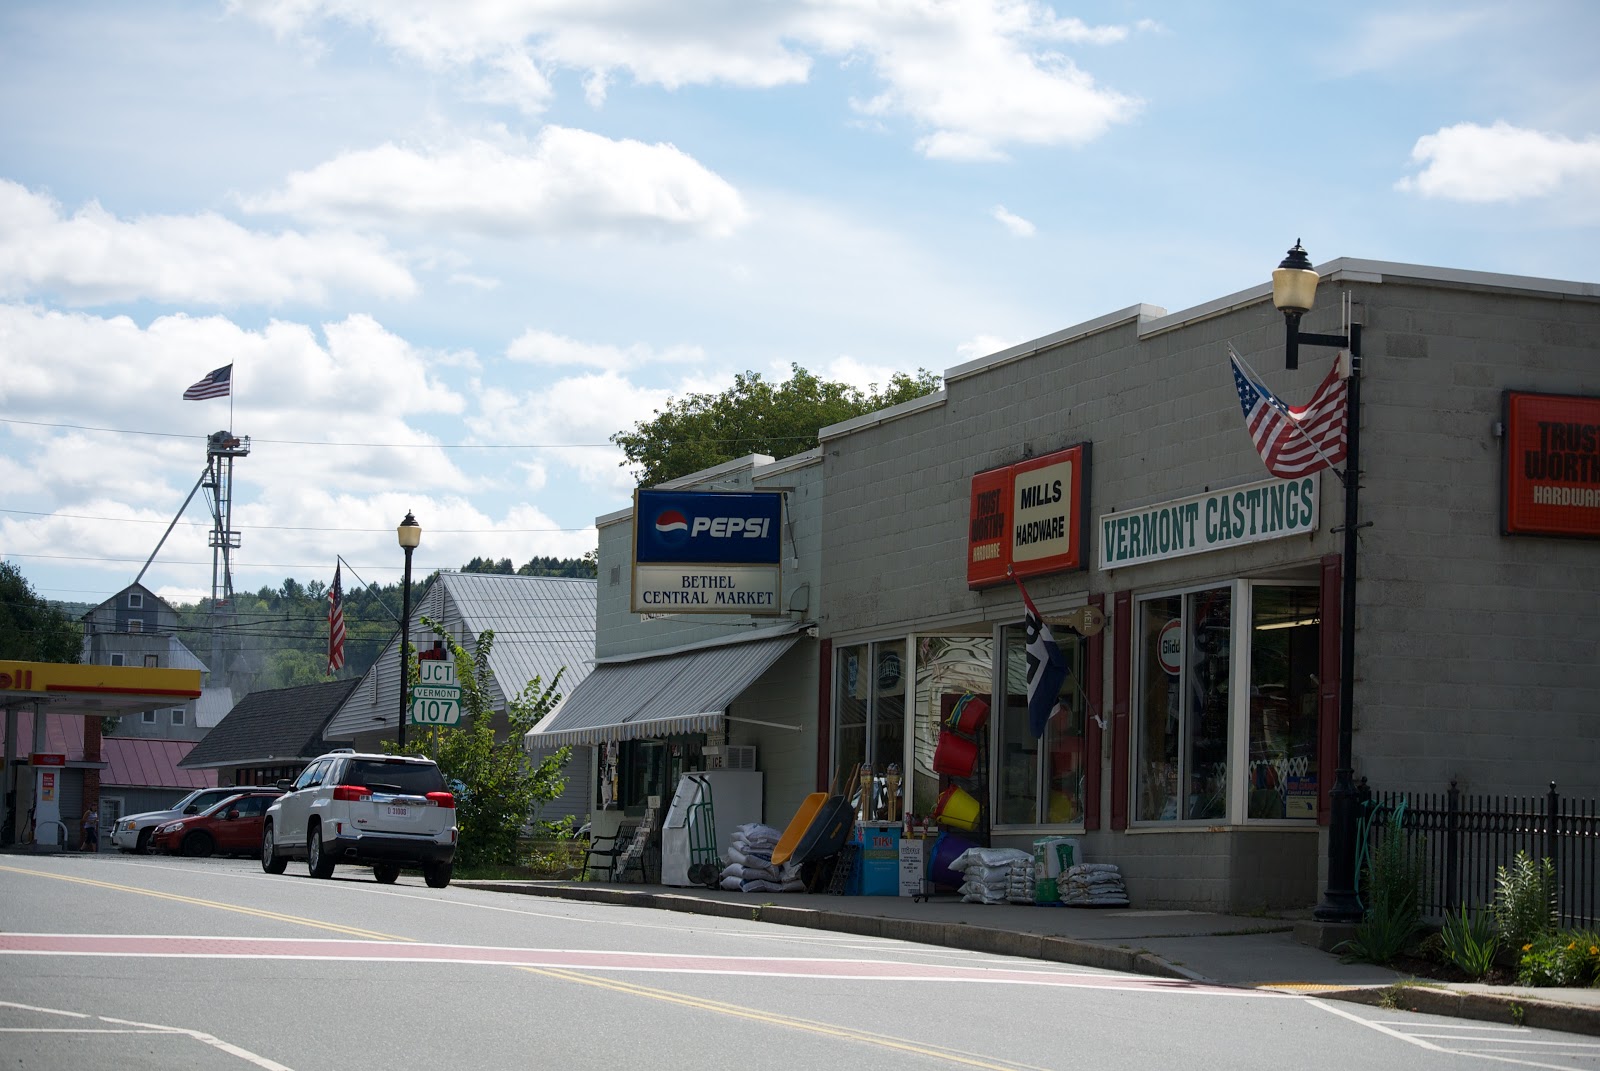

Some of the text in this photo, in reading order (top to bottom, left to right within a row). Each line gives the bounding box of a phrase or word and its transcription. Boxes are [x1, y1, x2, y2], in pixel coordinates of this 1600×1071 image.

[1020, 480, 1062, 510] MILLS
[691, 517, 770, 538] PEPSI
[1104, 478, 1314, 563] VERMONT CASTINGS
[1016, 516, 1065, 547] HARDWARE
[681, 575, 736, 589] BETHEL
[642, 590, 774, 605] CENTRAL MARKET
[423, 664, 453, 681] JCT
[417, 688, 458, 698] VERMONT
[420, 700, 453, 722] 107
[712, 756, 722, 768] ICE
